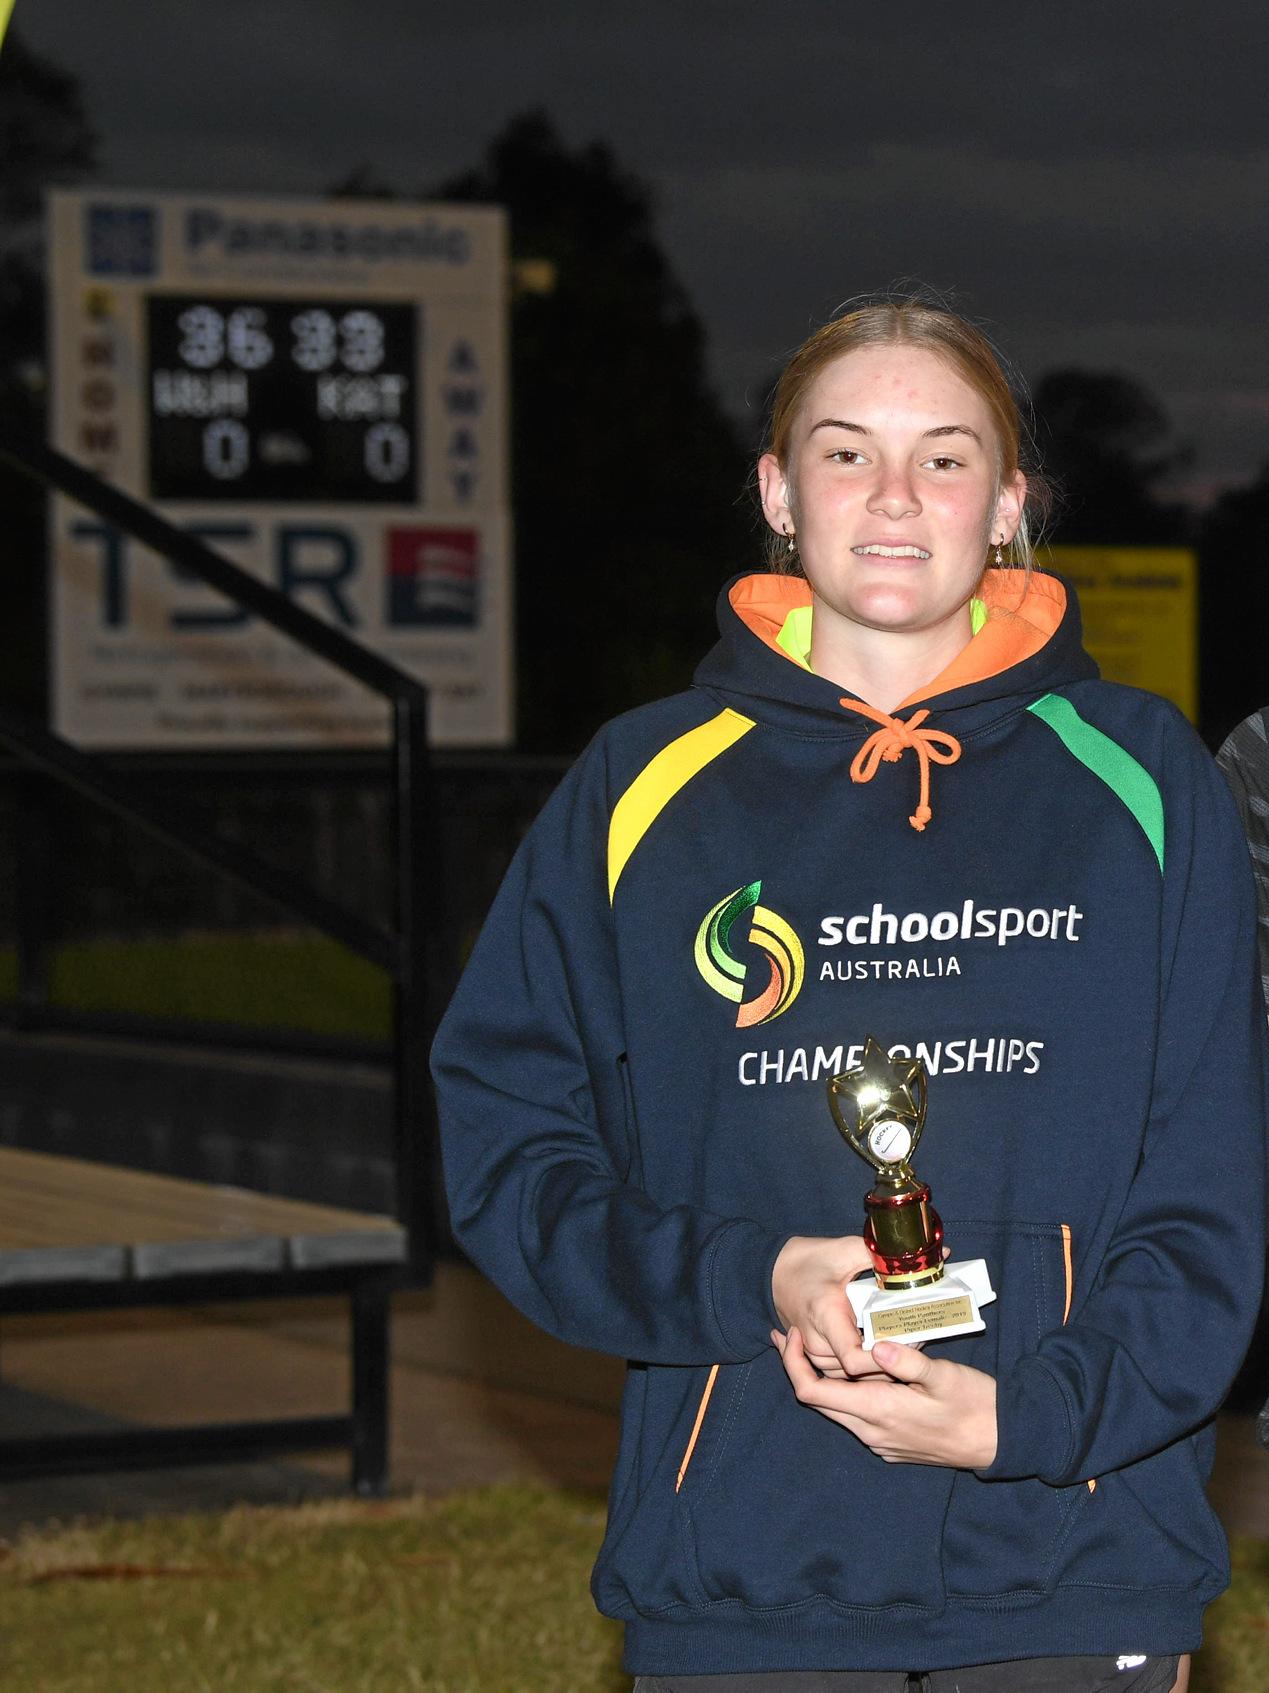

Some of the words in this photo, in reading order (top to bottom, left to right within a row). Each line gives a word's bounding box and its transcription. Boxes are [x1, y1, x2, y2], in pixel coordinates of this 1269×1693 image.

[189, 210, 468, 261] Panasonic
[178, 306, 273, 370] 36
[291, 309, 385, 373] 33
[204, 418, 250, 481] 0
[364, 420, 410, 483] 0
[818, 899, 1083, 946] schoolsport
[819, 956, 962, 981] AUSTRALIA
